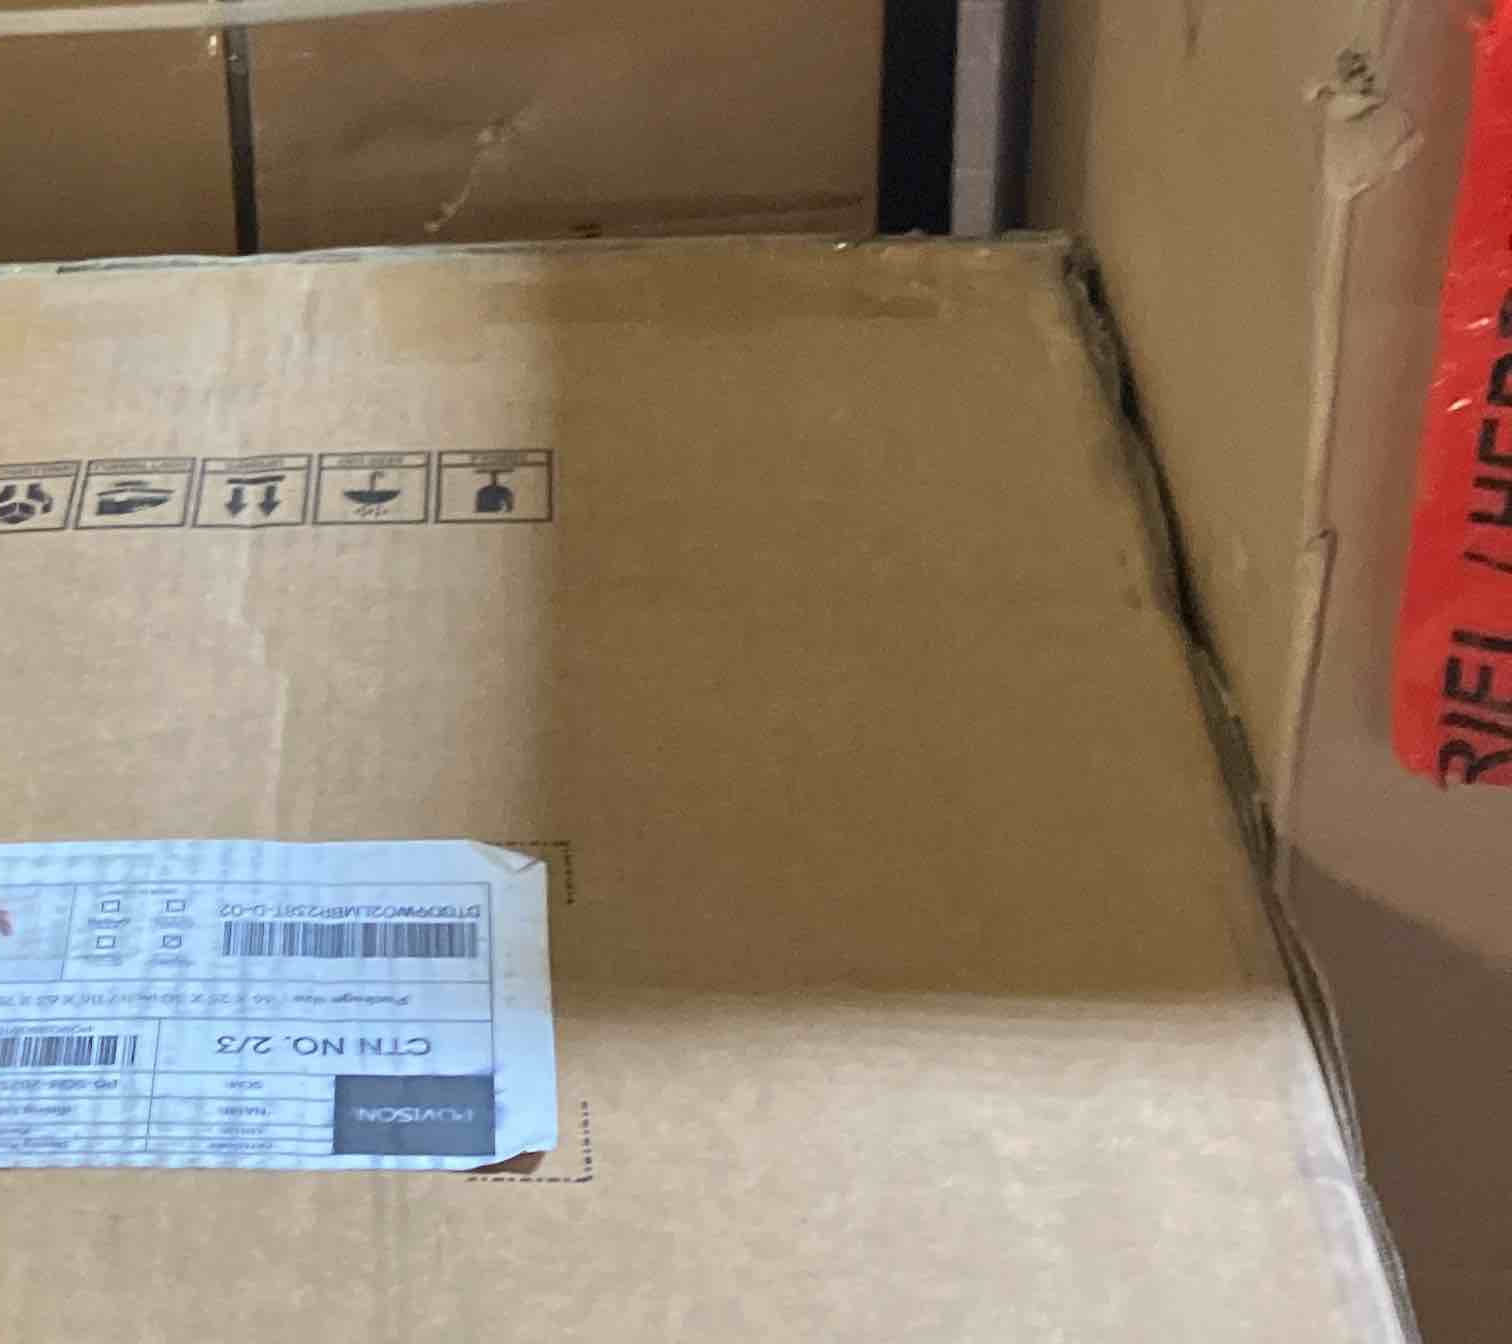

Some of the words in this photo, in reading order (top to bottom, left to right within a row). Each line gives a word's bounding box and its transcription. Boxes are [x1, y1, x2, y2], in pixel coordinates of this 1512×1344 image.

[216, 1036, 272, 1055] 2/3
[285, 1036, 345, 1056] NO.
[360, 1036, 431, 1056] CTN
